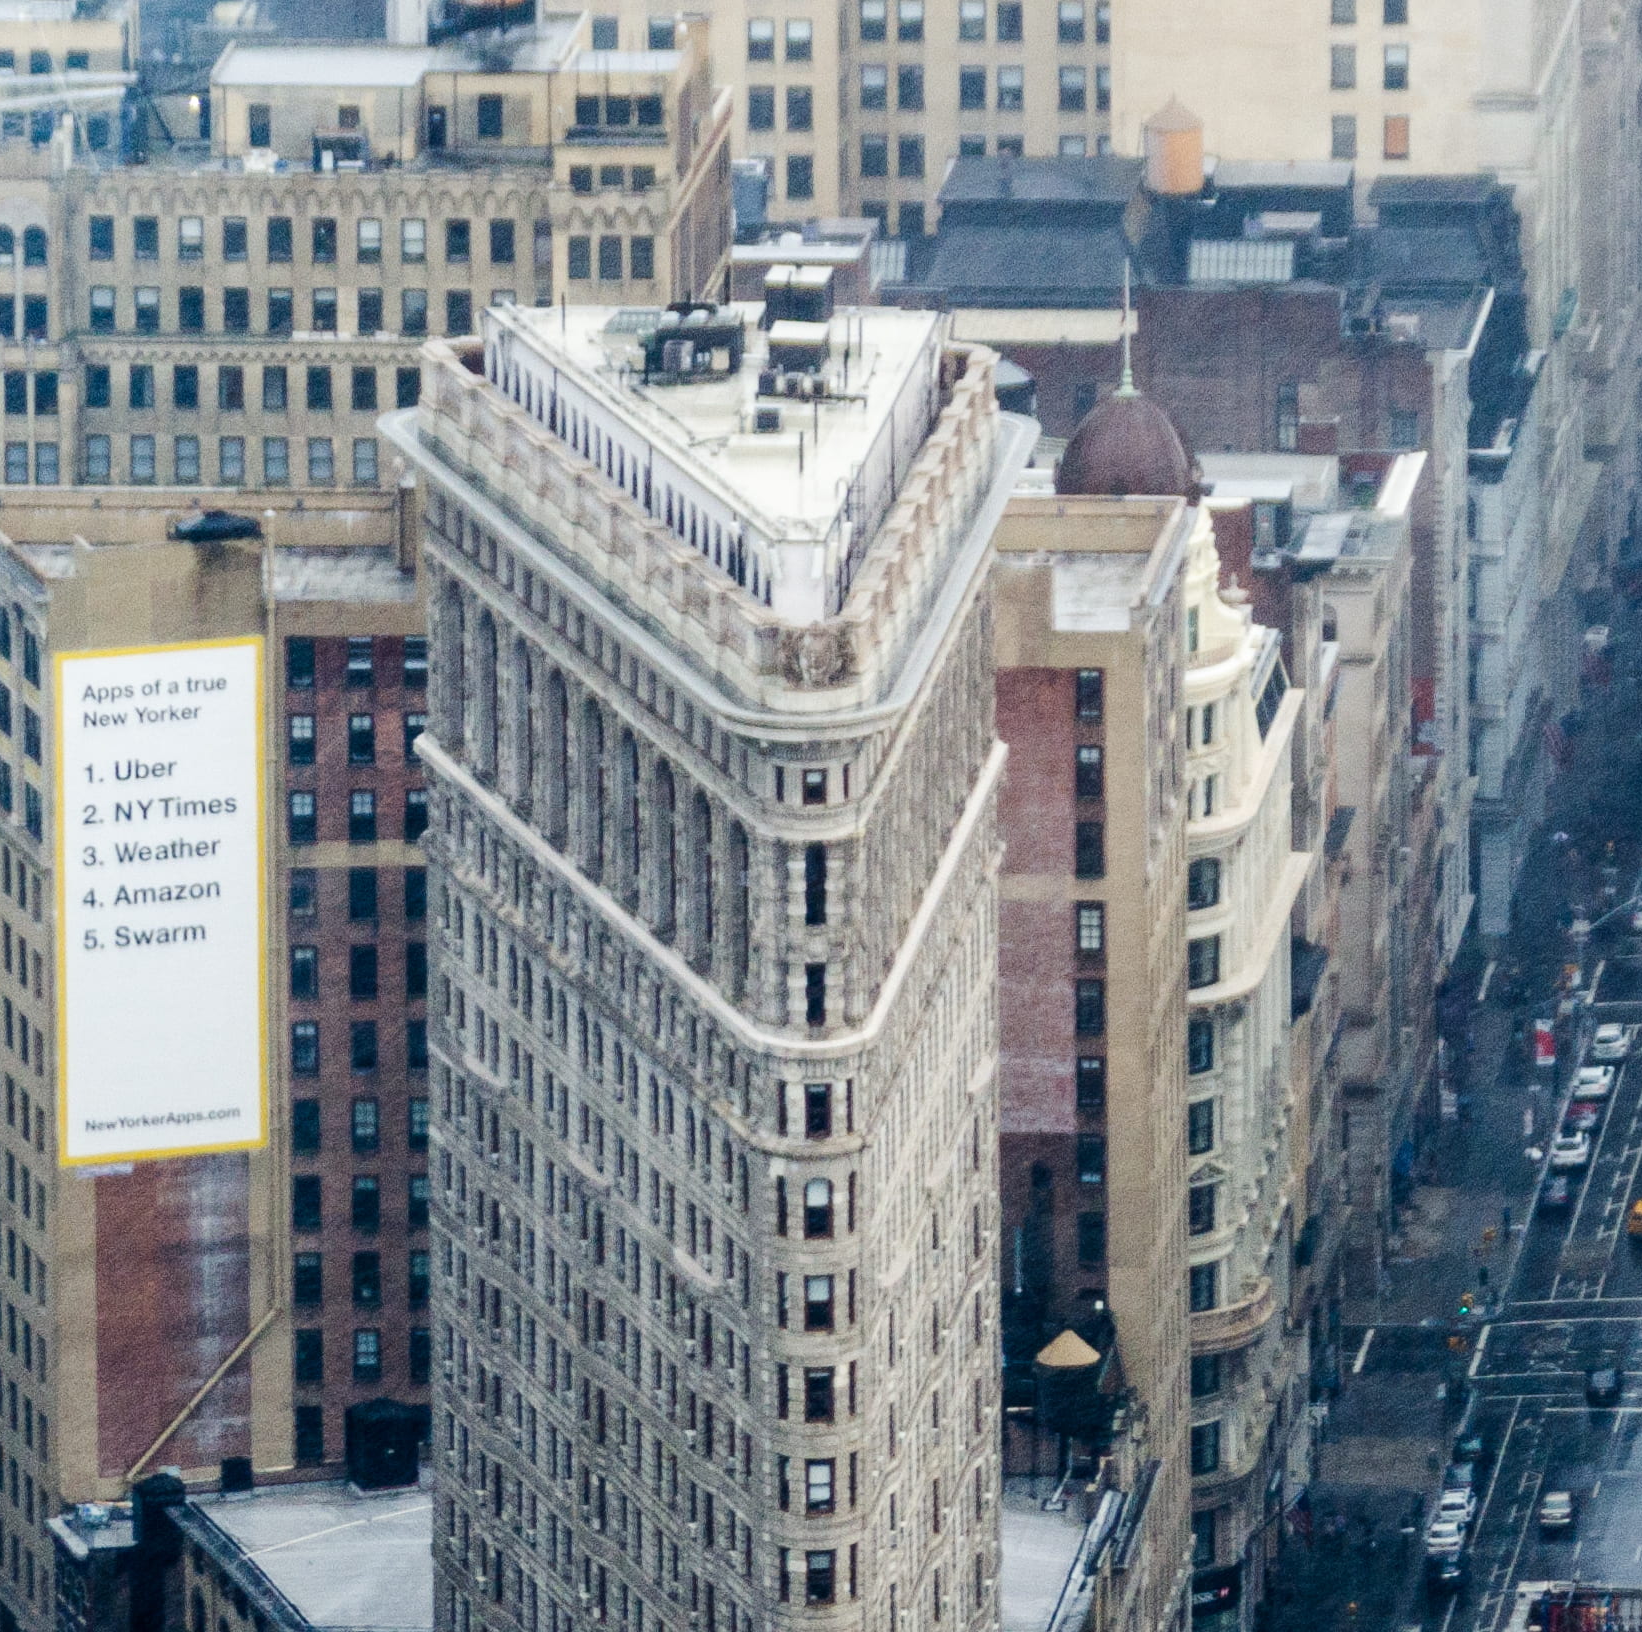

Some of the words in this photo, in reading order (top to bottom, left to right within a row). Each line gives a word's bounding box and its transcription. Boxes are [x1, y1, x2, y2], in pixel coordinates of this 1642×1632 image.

[82, 685, 134, 704] Apps
[141, 679, 162, 696] of
[168, 681, 179, 695] a
[187, 677, 227, 692] true
[84, 711, 128, 728] New
[135, 705, 202, 723] Yorker
[85, 763, 104, 783] 1.
[115, 758, 177, 781] Uber
[83, 804, 104, 825] 2.
[158, 796, 237, 818] Times
[83, 846, 104, 867] 3.
[115, 837, 221, 864] Weather
[83, 888, 104, 908] 4.
[114, 881, 221, 906] Amazon
[84, 929, 105, 950] 5.
[115, 924, 206, 947] Swarm
[85, 1107, 241, 1131] NewYorkerApps.com
